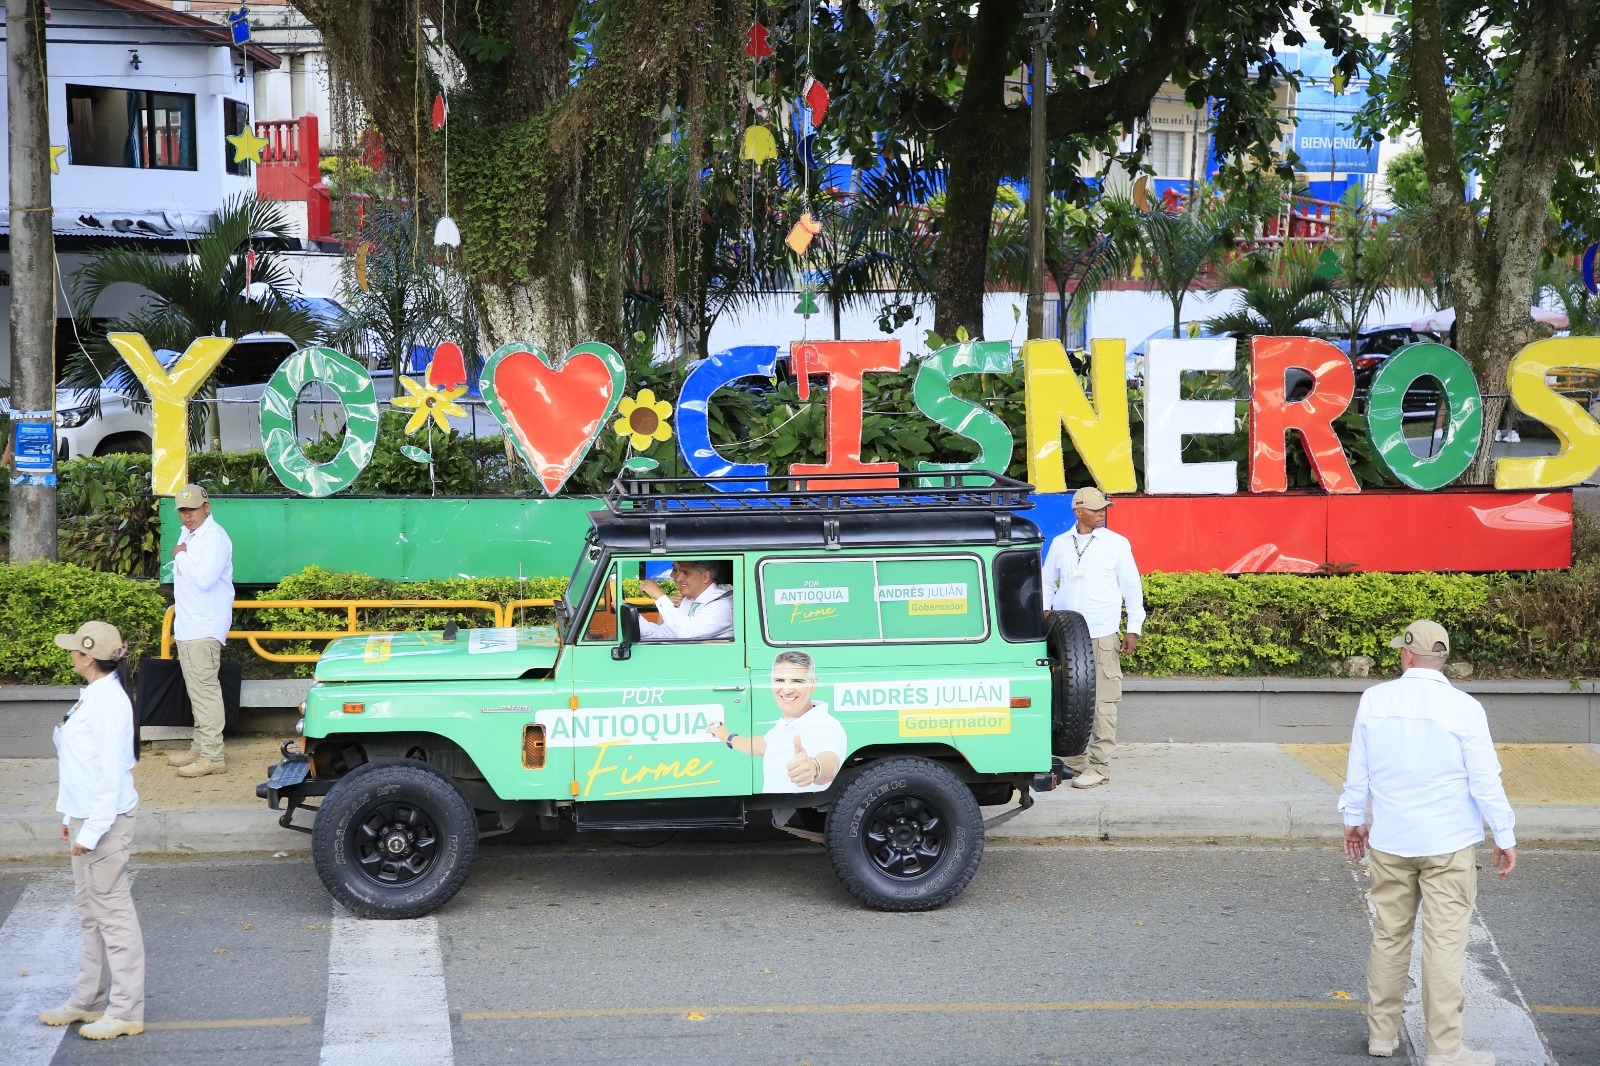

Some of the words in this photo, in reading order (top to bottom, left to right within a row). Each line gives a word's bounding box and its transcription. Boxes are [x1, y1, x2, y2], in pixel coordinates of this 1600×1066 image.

[107, 331, 379, 498] YO
[674, 335, 1600, 496] CISNEROS
[804, 580, 819, 588] POR
[878, 585, 925, 598] ANDRÉS
[927, 584, 963, 599] JULIÁN
[781, 590, 843, 602] ANTIOQUIA
[911, 603, 964, 612] Gobernador
[790, 602, 837, 624] Firme
[622, 686, 665, 705] POR
[841, 684, 929, 706] ANDRÉS
[935, 681, 1002, 706] JULIÁN
[550, 712, 709, 742] ANTIOQUIA
[905, 714, 1005, 730] Gobernador
[583, 738, 714, 797] Firme
[850, 779, 907, 838] NEXEN
[334, 793, 371, 865] ROADIAN
[925, 825, 966, 892] ROADIAN
